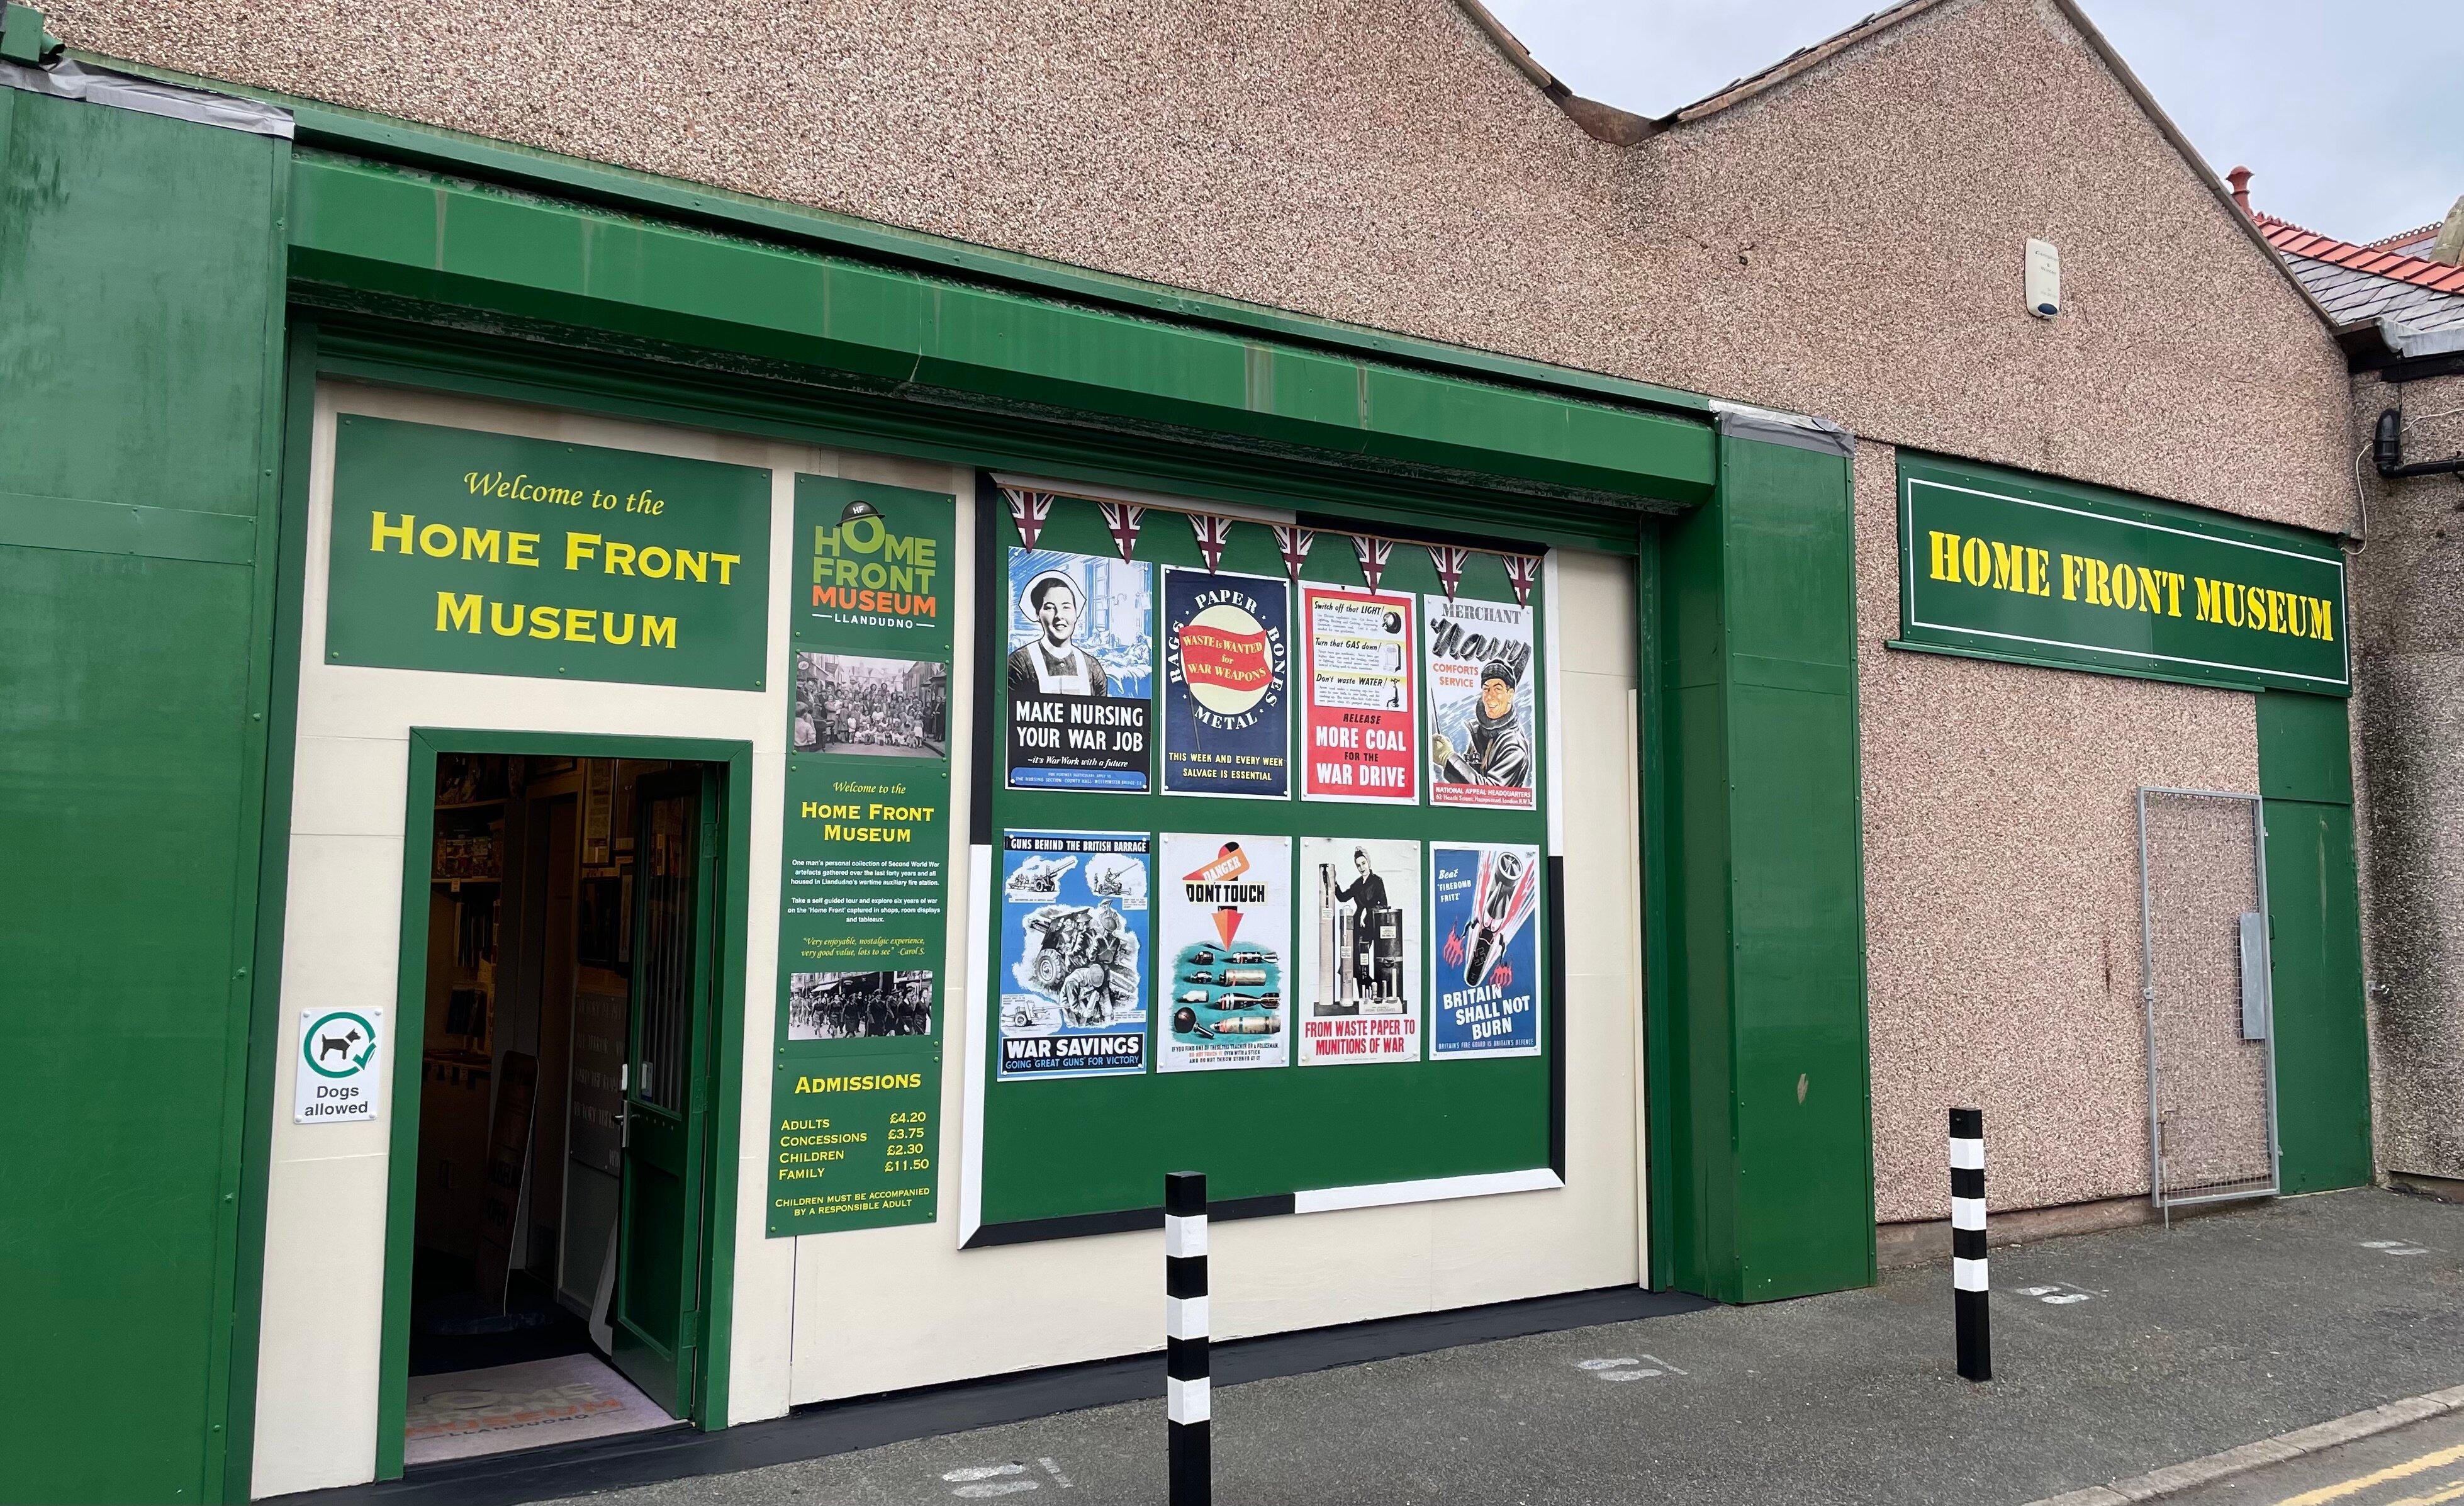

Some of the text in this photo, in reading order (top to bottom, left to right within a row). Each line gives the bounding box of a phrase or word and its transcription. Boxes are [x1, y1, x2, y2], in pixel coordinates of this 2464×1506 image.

[464, 471, 664, 515] Welcome to the
[853, 505, 865, 515] HF
[369, 511, 740, 585] HOME FRONT
[815, 515, 936, 567] HOME
[813, 557, 935, 594] FRONT
[1929, 531, 2334, 643] HOME FRONT MUSEUM
[812, 585, 936, 617] MUSEUM
[1195, 590, 1257, 614] PAPER
[1315, 601, 1333, 610] Switch
[1335, 604, 1344, 613] off
[435, 591, 678, 649] MUSEUM
[834, 614, 913, 629] LLANDUDNO
[1442, 603, 1521, 624] MERCHANT
[1168, 621, 1184, 684] RAGS
[1182, 635, 1214, 647] WASTE
[1223, 640, 1262, 655] WANTED
[1316, 638, 1328, 646] Turn
[1330, 639, 1343, 647] that
[1346, 641, 1360, 649] GAS
[1221, 654, 1233, 664] for
[1265, 626, 1285, 707] BONES
[1187, 663, 1266, 682] WAR WEAPONS
[1316, 673, 1333, 682] Don't
[1433, 663, 1479, 675] COMFORTS
[1439, 677, 1474, 688] SERVICE
[1016, 700, 1143, 727] MAKE NURSING
[1195, 705, 1258, 730] METAL
[1343, 713, 1381, 724] RELEASE
[1017, 727, 1143, 751] YOUR WAR JOB
[1316, 726, 1406, 751] MORE COAL
[1104, 758, 1128, 768] future
[1169, 753, 1283, 767] THIS WEEK AND EVERY WEEK
[1344, 751, 1378, 761] FOR THE
[1183, 768, 1272, 780] SALVAGE IS ESSENTIAL
[1316, 763, 1405, 787] WAR DRIVE
[833, 782, 876, 793] Welcome
[892, 784, 906, 794] the
[802, 802, 934, 821] HOME FRONT
[824, 824, 910, 842] MUSEUM
[1011, 838, 1146, 852] GUNS BEHIND THE BRITISH BARRAGE
[1202, 856, 1241, 881] DANGER
[1438, 869, 1459, 880] Beat
[1186, 882, 1265, 902] DON'T TOUCH
[824, 936, 856, 948] enjoyable,
[860, 936, 889, 948] nostalgic
[890, 938, 924, 947] experience,
[1443, 984, 1502, 1009] BRITAIN
[1455, 996, 1530, 1025] SHALL NOT
[1305, 1019, 1414, 1038] FROM WASTE PAPER TO
[1472, 1018, 1512, 1040] BURN
[1007, 1037, 1139, 1059] WAR SAVINGS
[1316, 1037, 1404, 1055] MUNITIONS OF WAR
[1005, 1059, 1031, 1069] GOING
[1107, 1055, 1140, 1064] VICTORY
[317, 1086, 359, 1100] Dogs
[795, 1073, 921, 1094] ADMISSIONS
[305, 1101, 367, 1116] allowed
[781, 1112, 926, 1130] ADULTS £4.20
[780, 1128, 924, 1147] CONCESSIONS £3.75
[780, 1144, 923, 1163] CHILDREN £2.30
[779, 1159, 929, 1180] FAMILY £11.50
[775, 1197, 823, 1207] CHILDREN
[827, 1194, 851, 1203] MUST
[869, 1188, 929, 1200] ACCOMPANIED
[818, 1203, 879, 1215] RESPONSIBLE
[882, 1200, 912, 1208] ADULT
[450, 1414, 590, 1437] LLANDUDNO
